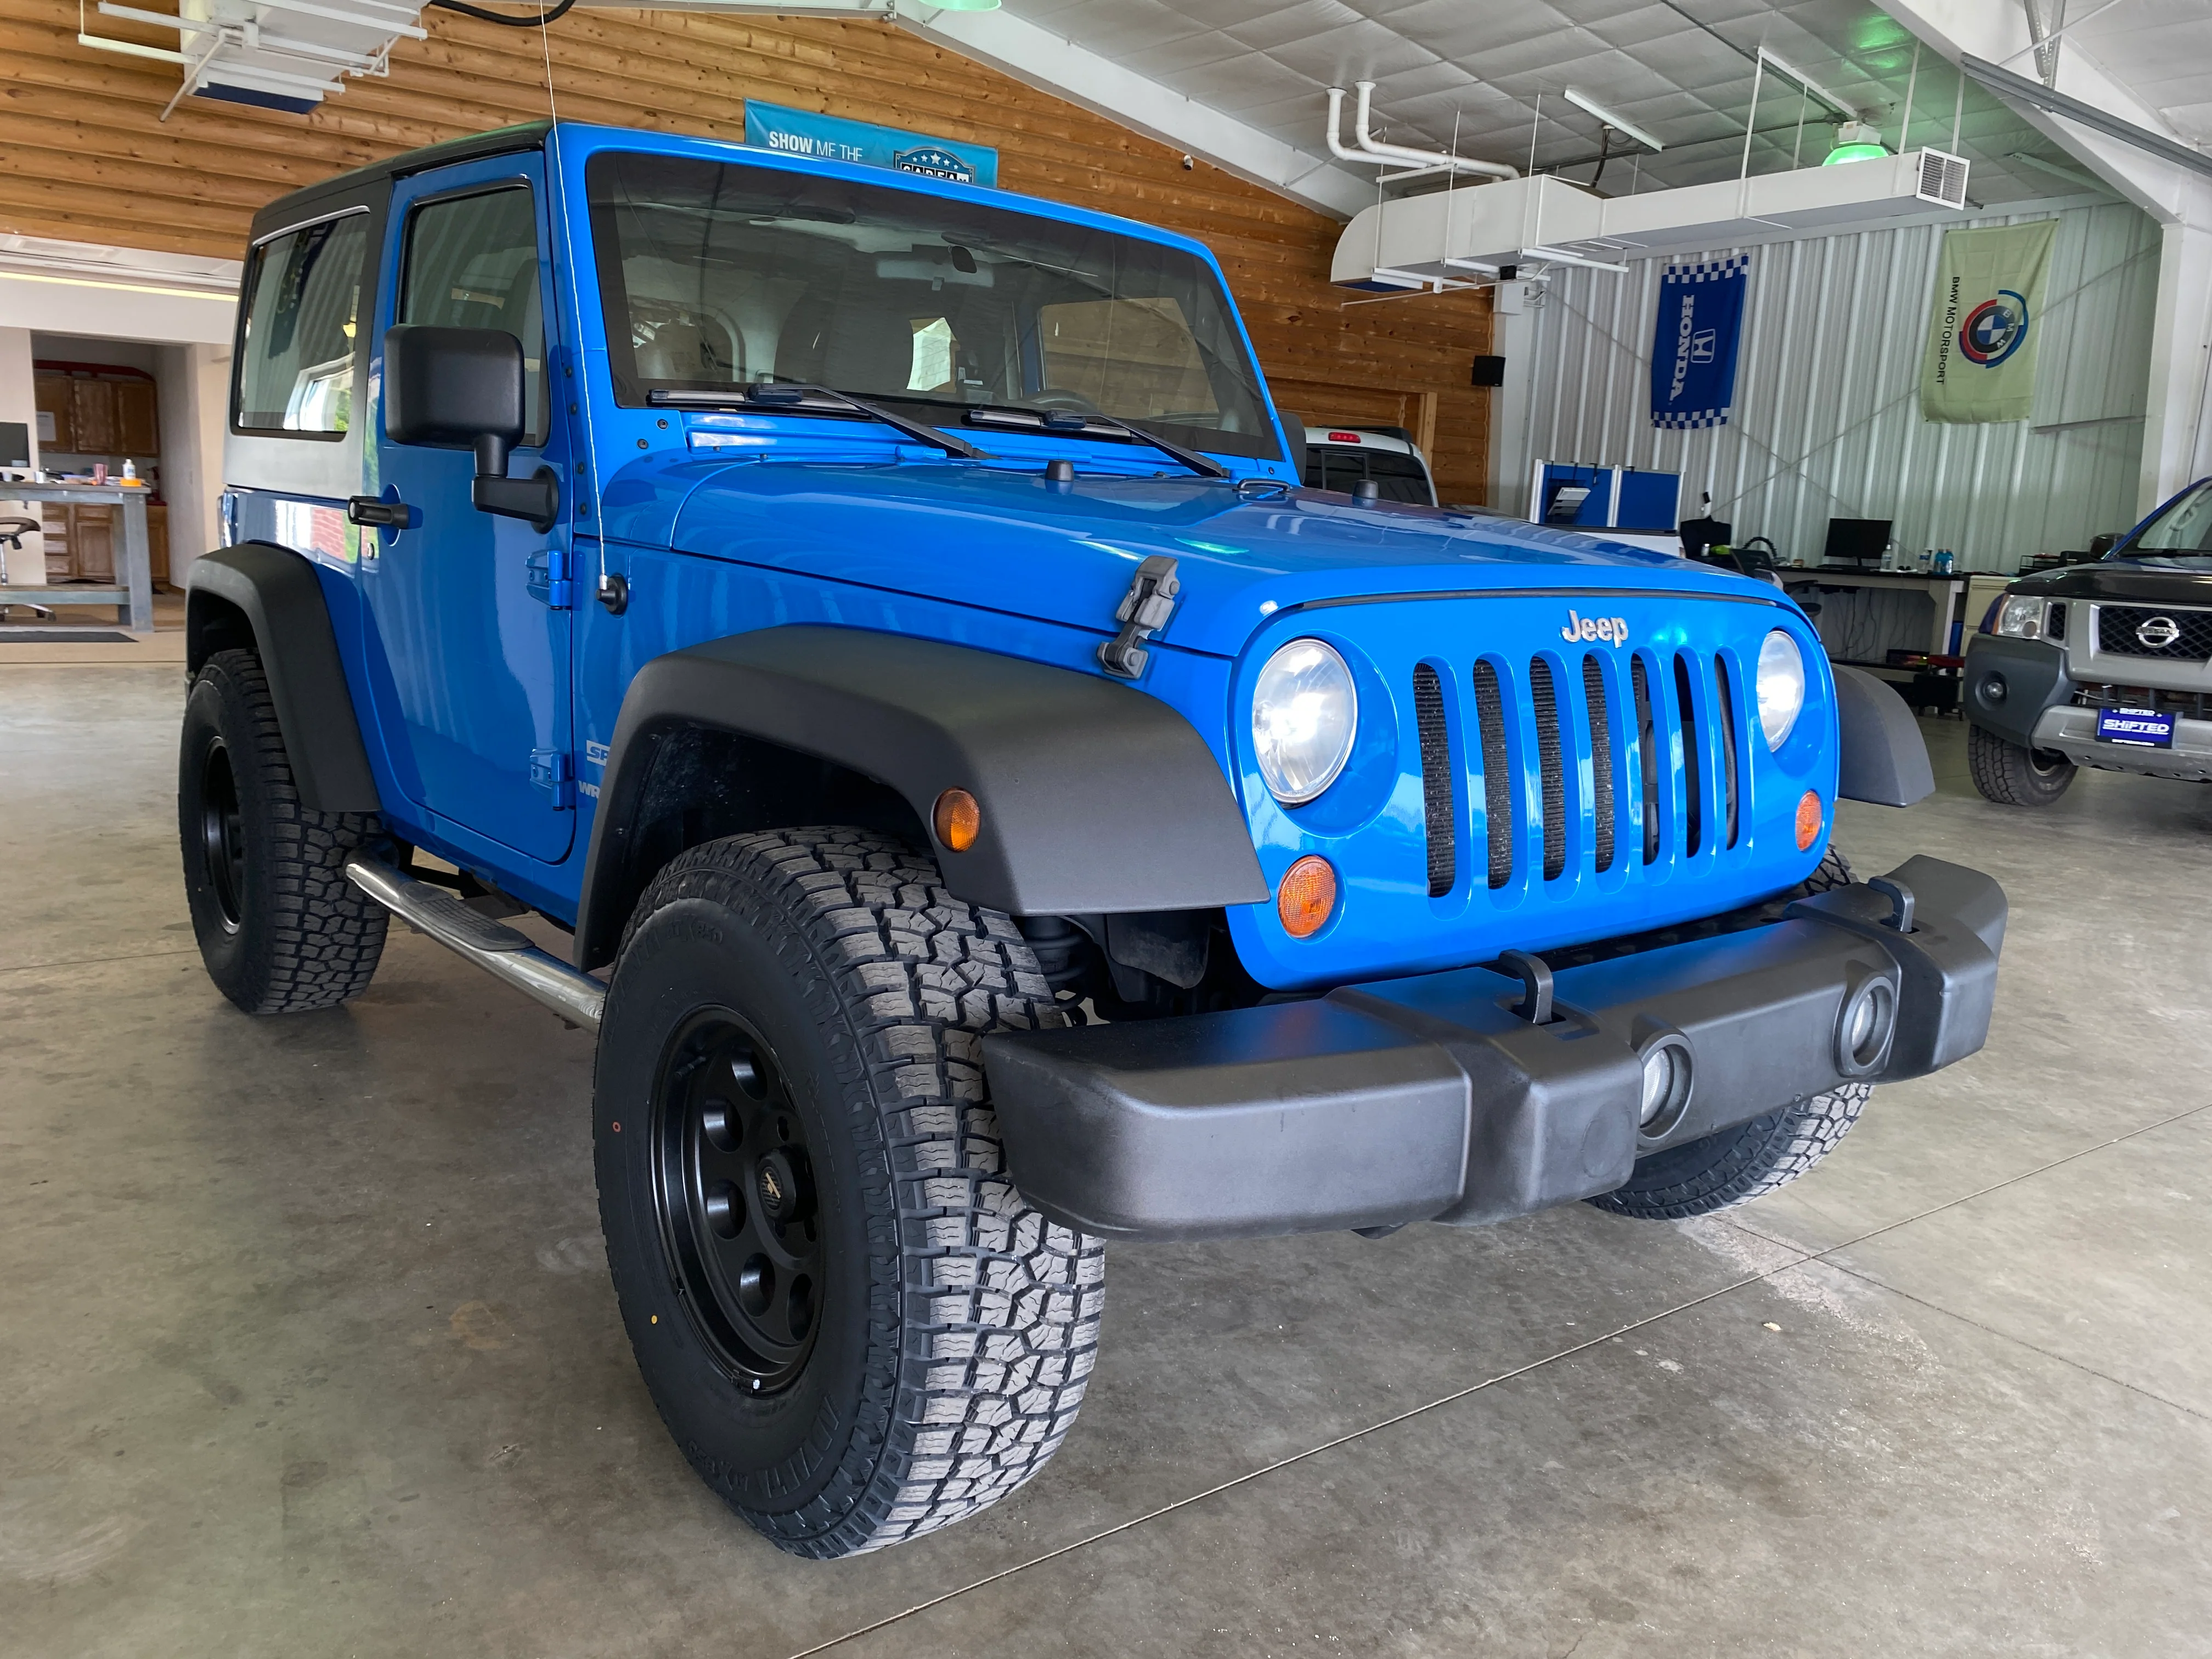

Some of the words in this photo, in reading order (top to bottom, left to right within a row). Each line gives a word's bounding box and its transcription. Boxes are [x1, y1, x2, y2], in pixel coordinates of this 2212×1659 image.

[769, 131, 813, 154] SHOW
[1949, 276, 1960, 303] BMW
[1669, 295, 1695, 401] HONDA
[1936, 307, 1957, 385] MOTORSPORT
[1561, 609, 1629, 648] Jeep
